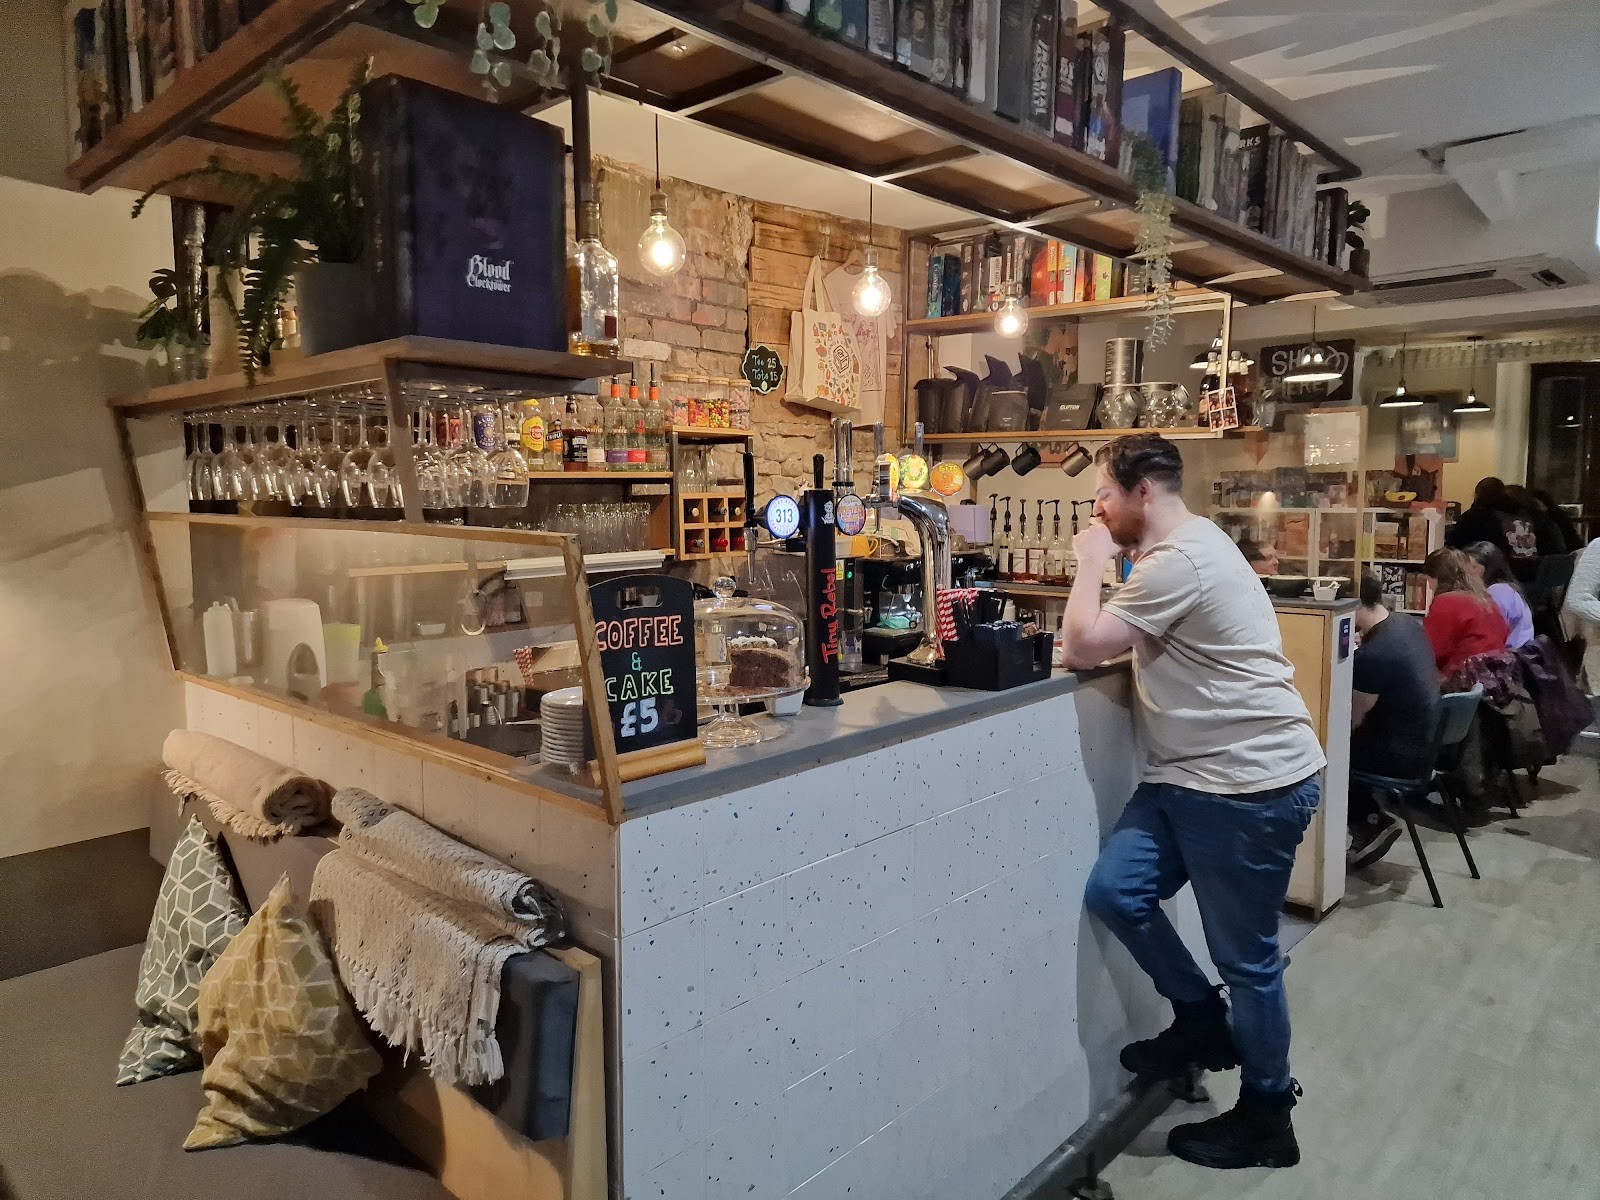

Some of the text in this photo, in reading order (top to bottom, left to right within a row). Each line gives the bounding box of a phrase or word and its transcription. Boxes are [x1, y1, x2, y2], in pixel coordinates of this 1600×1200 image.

[467, 254, 514, 280] Blood
[767, 357, 777, 369] 25
[770, 371, 779, 381] 15
[776, 508, 793, 523] 313
[820, 568, 839, 665] Tiny Rebel
[595, 614, 684, 652] COFFEE
[631, 651, 643, 672] &
[605, 668, 675, 703] CAKE
[620, 697, 660, 739] £5
